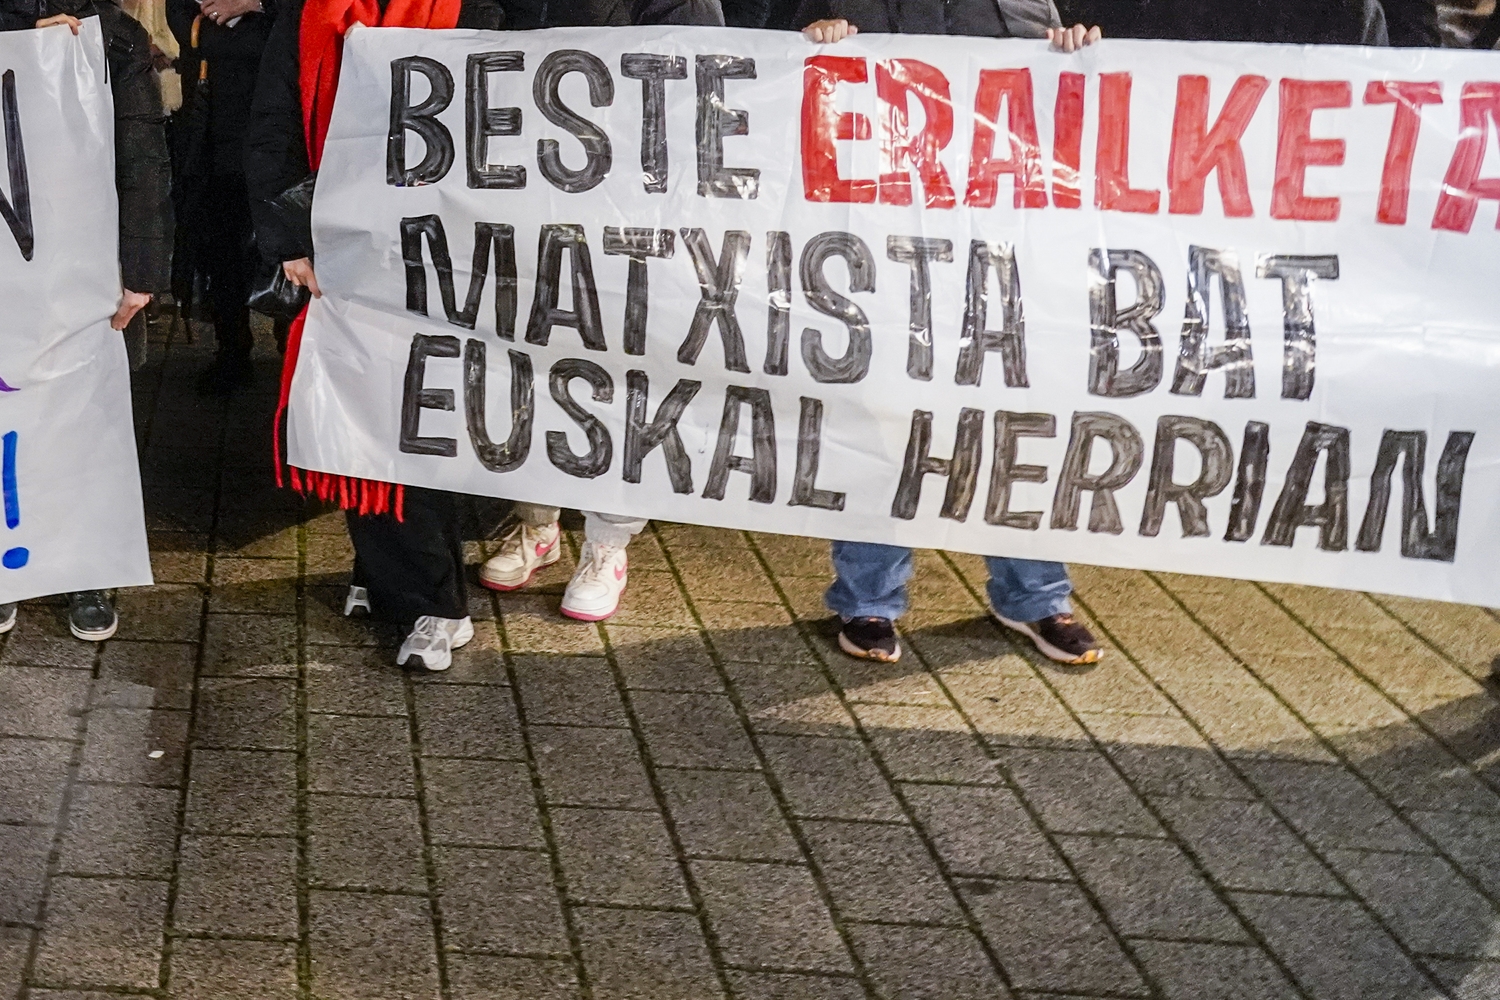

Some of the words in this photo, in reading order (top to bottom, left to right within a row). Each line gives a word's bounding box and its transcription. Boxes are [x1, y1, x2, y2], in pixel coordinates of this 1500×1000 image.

[386, 48, 761, 199] BESTE
[800, 55, 1500, 233] ERAILKETA
[399, 214, 1030, 388] MATXISTA
[1087, 244, 1340, 401] BAT
[399, 332, 846, 513] EUSKAL
[891, 407, 1475, 563] HERRIAN
